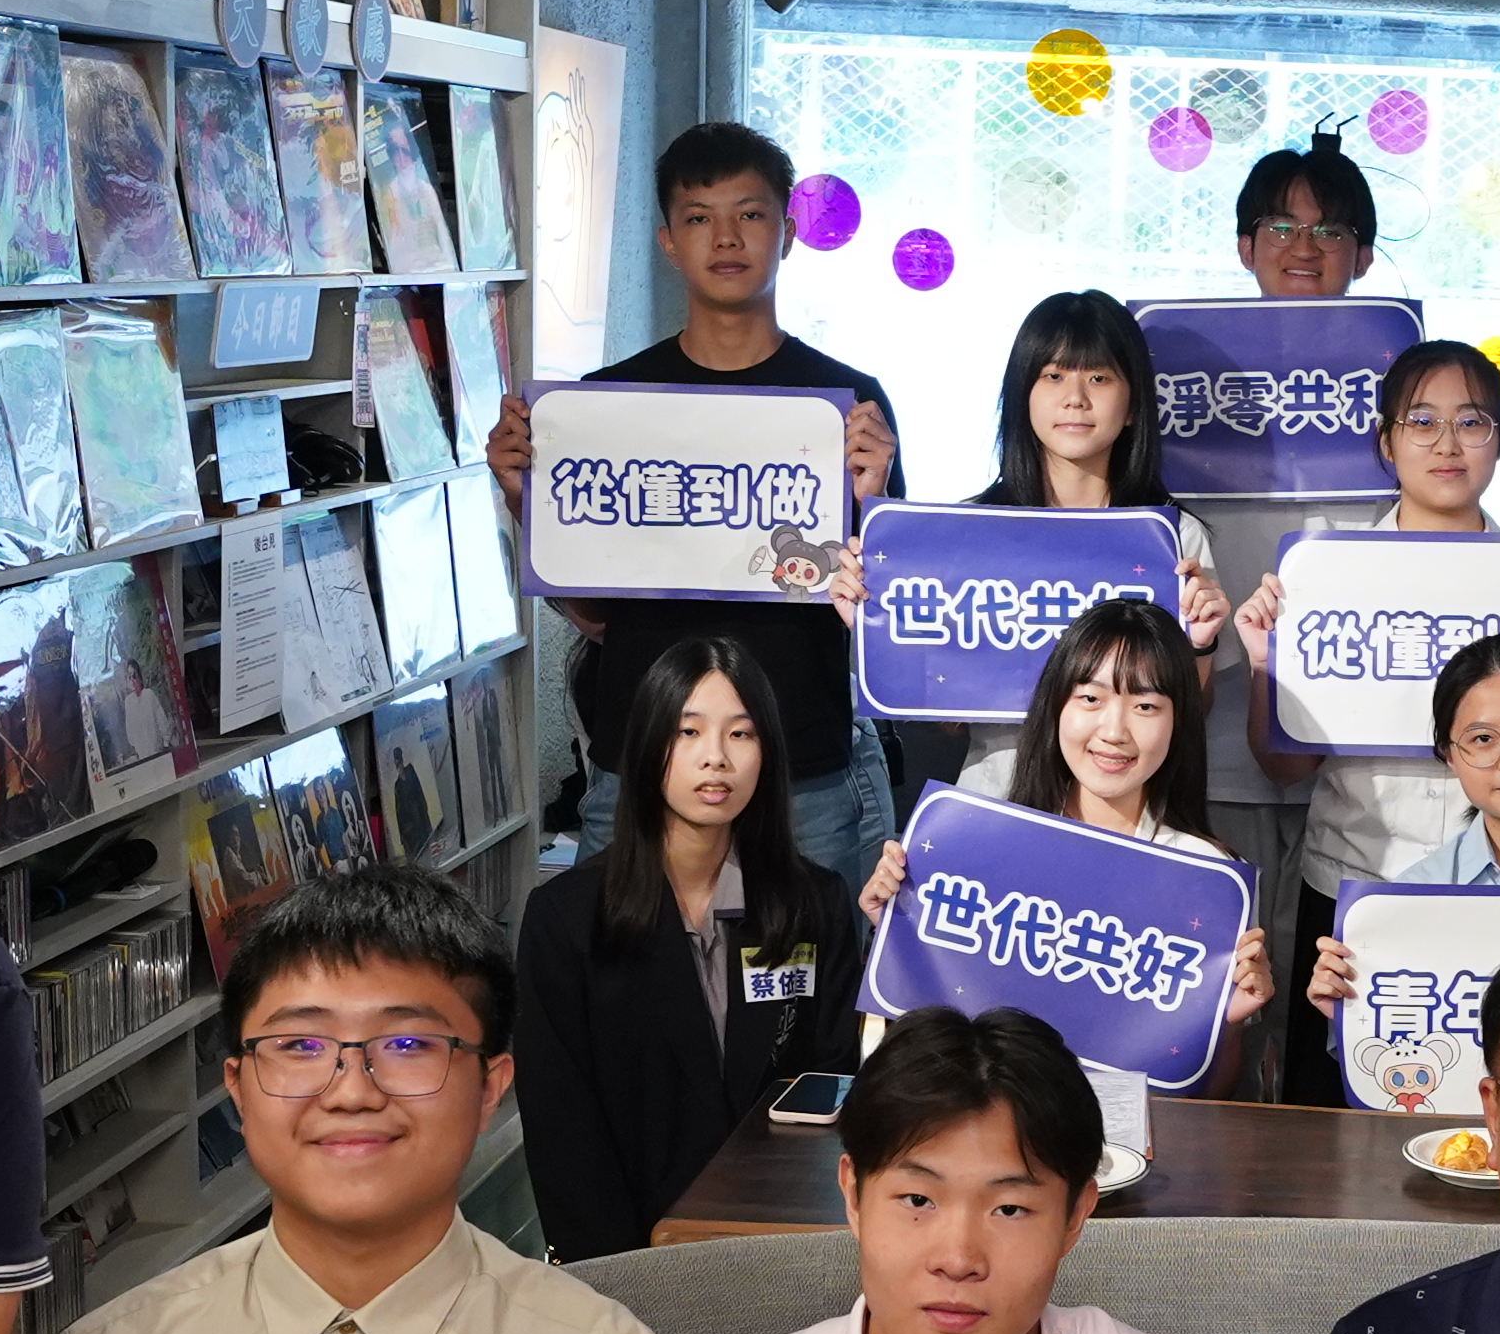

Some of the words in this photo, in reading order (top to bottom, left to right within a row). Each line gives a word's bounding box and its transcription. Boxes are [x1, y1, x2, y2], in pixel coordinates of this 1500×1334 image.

[552, 459, 822, 529] 從懂到做
[916, 870, 1207, 1013] 世代共好
